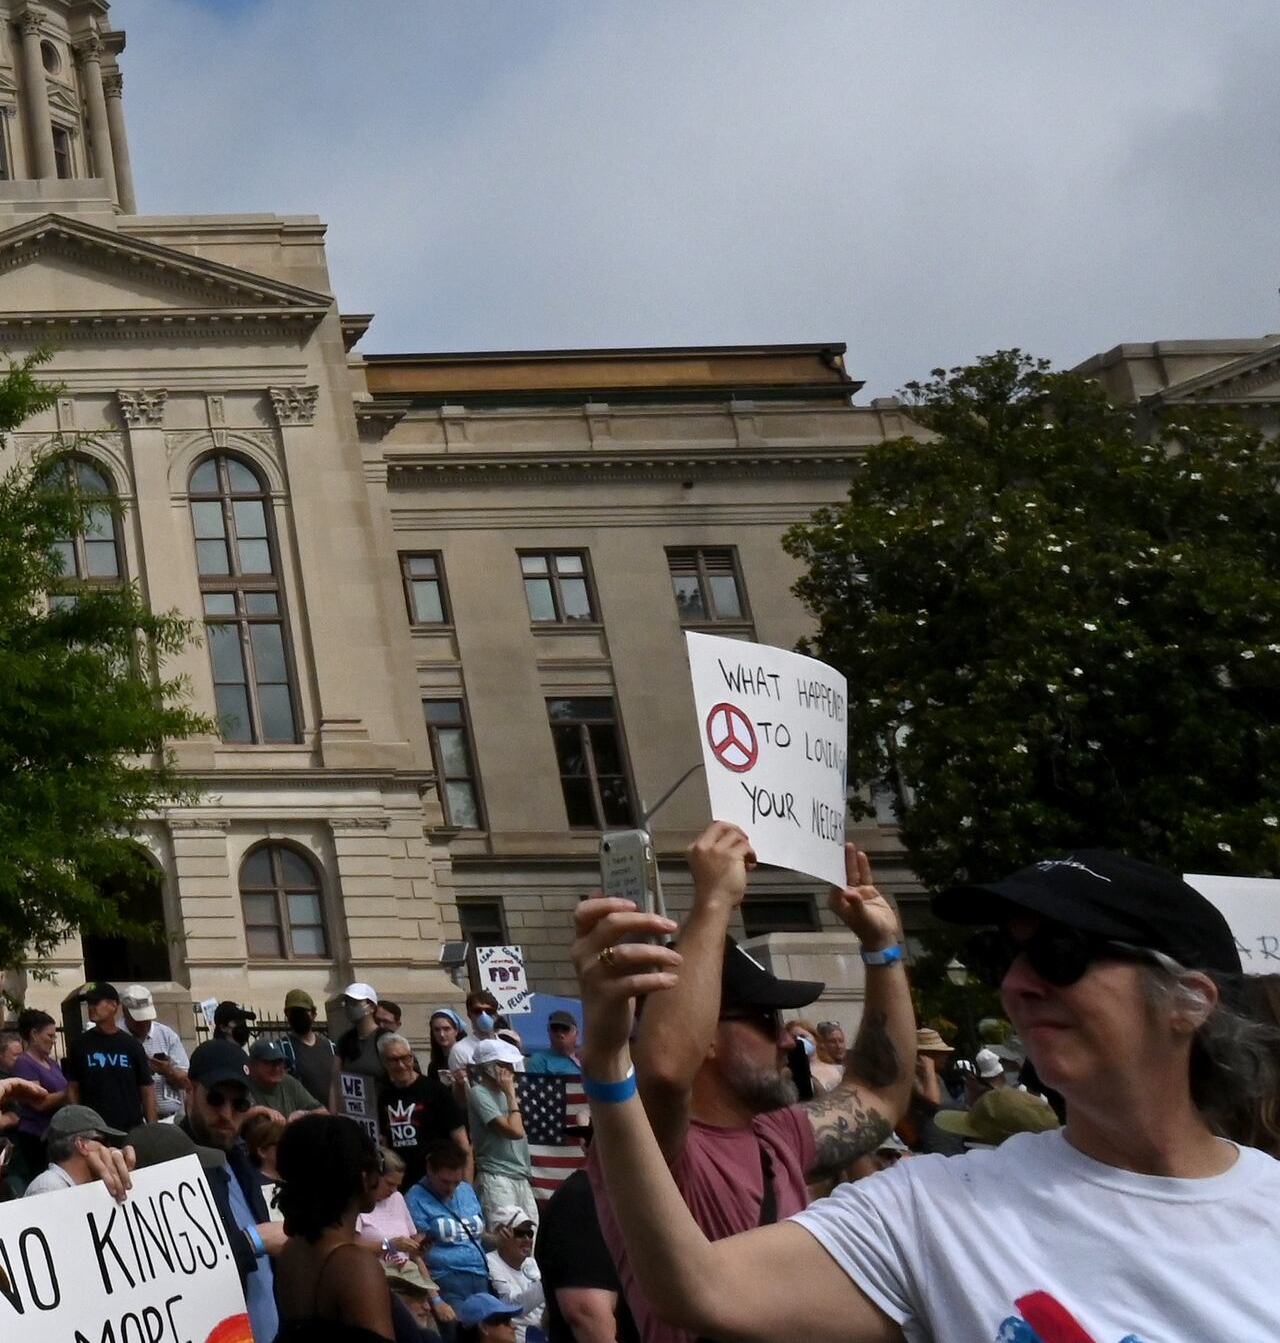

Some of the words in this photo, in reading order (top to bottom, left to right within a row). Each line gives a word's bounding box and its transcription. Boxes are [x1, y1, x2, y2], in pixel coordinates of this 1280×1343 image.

[718, 658, 781, 701] WHAT
[757, 722, 790, 747] TO
[741, 781, 801, 828] YOUR
[489, 967, 520, 982] FDT
[343, 1077, 362, 1096] WE
[392, 1125, 416, 1141] NO
[86, 1177, 230, 1295] KINGS!
